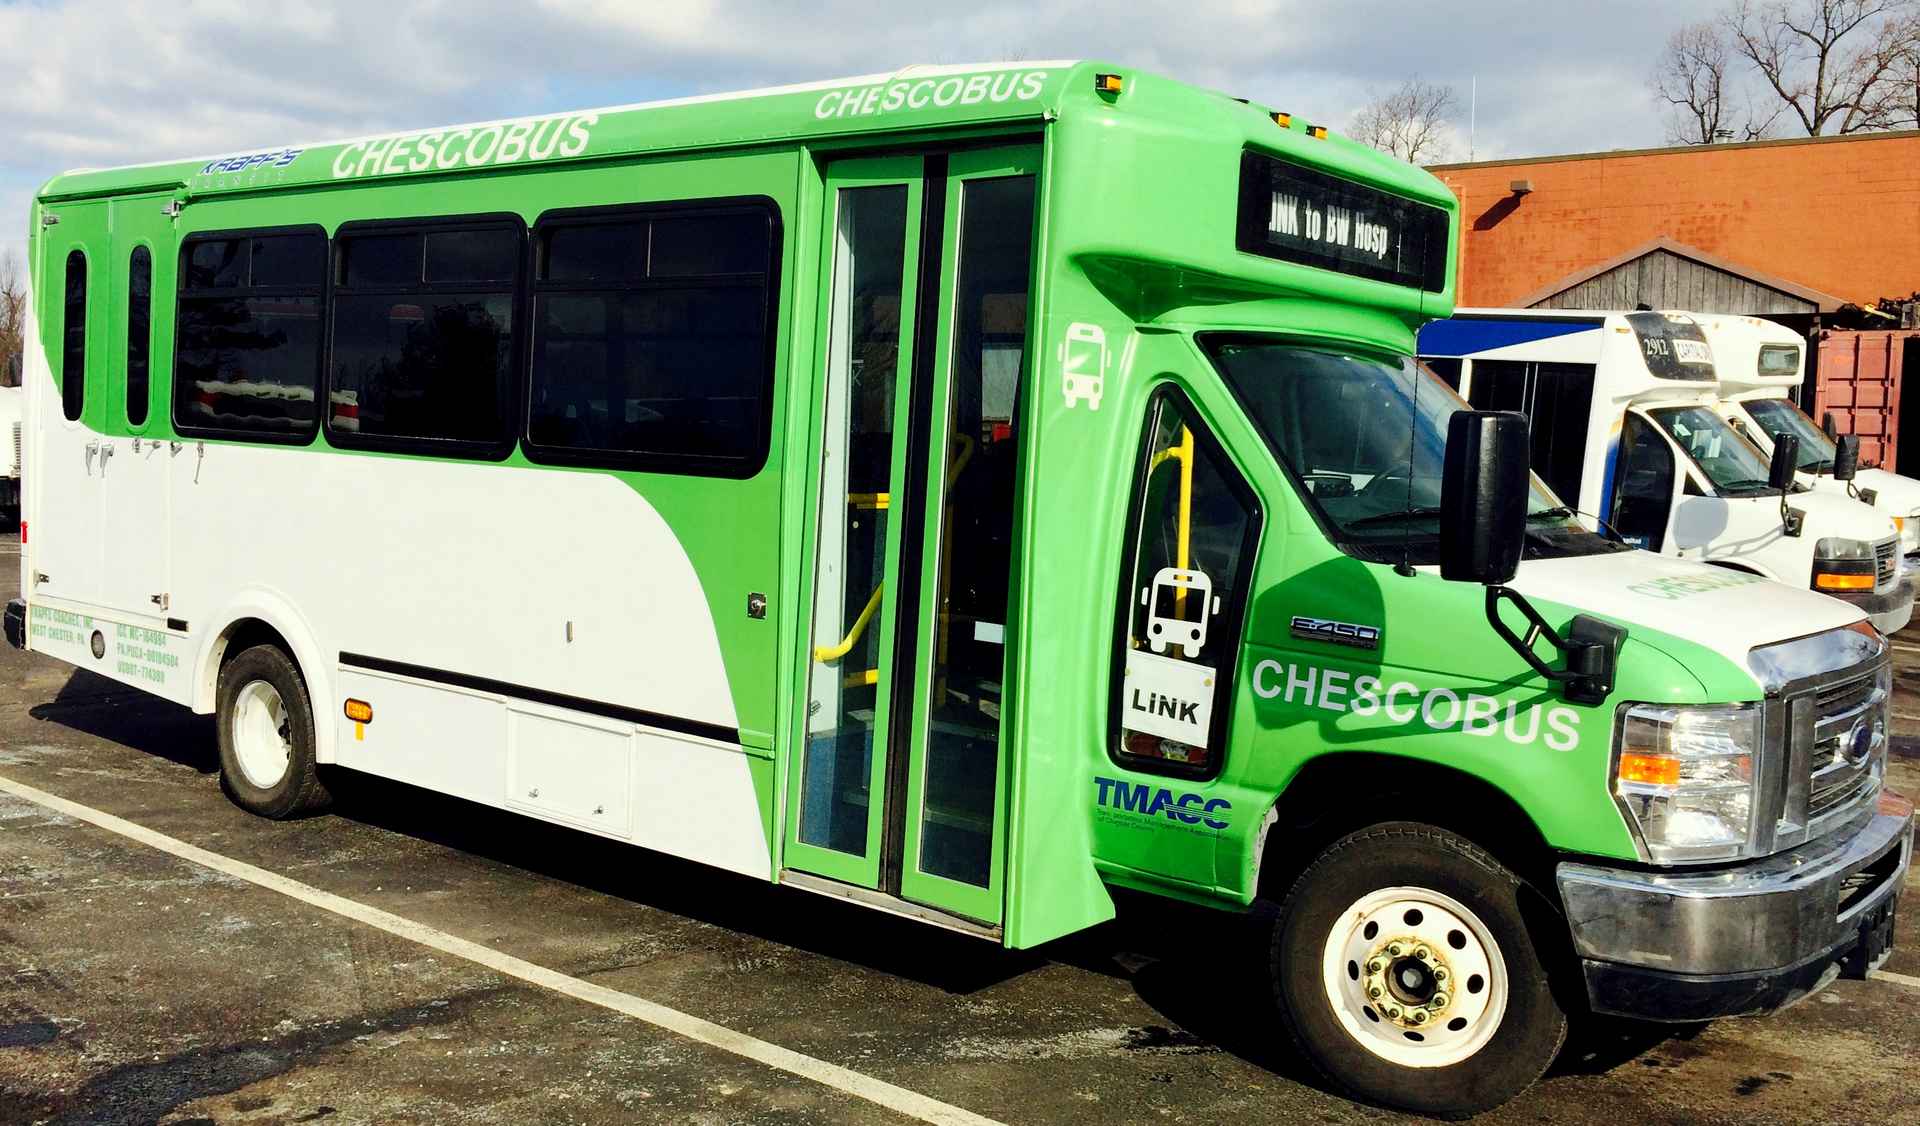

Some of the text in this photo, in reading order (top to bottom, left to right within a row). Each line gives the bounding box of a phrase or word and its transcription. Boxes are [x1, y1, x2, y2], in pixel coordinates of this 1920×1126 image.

[815, 71, 1048, 120] CHESCOBUS
[332, 113, 600, 180] CHESCOBUS
[1268, 191, 1388, 260] INK to BW Hosp
[1643, 338, 1669, 356] 2912
[31, 623, 47, 637] WEST
[77, 632, 85, 646] PA
[1253, 659, 1580, 752] CHESCOBUS
[1094, 777, 1232, 830] TMACC
[1097, 815, 1105, 823] of
